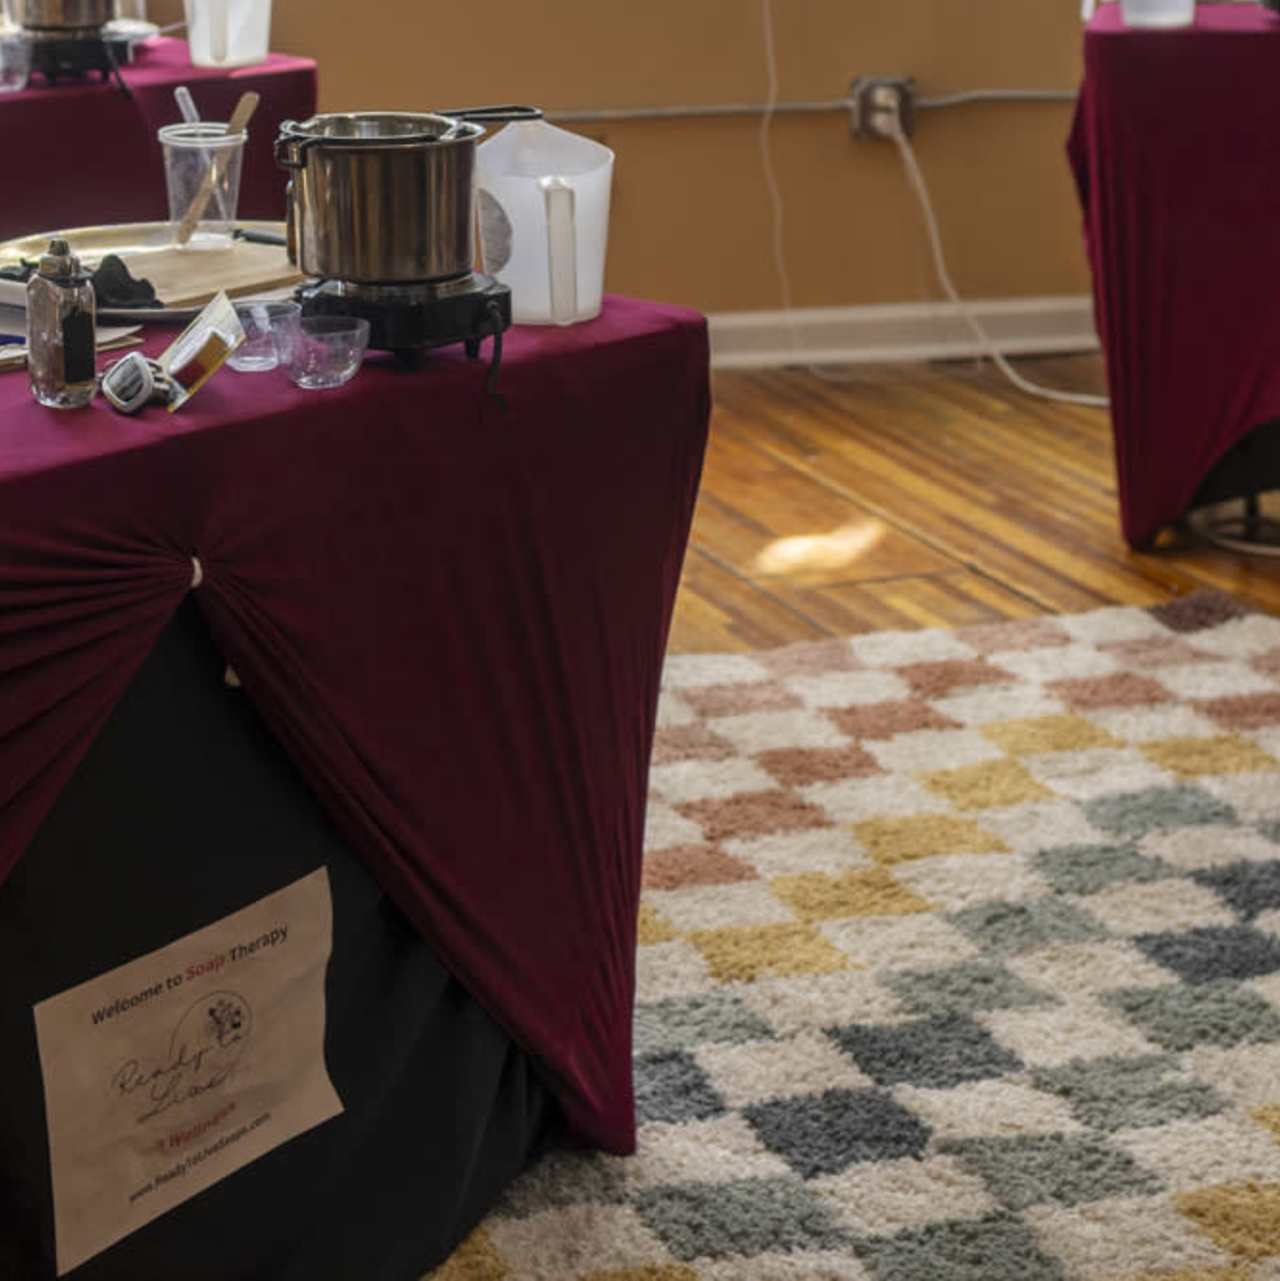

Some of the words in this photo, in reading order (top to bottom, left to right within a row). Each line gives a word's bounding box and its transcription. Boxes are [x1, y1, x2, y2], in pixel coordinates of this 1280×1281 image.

[91, 982, 163, 1025] Welcome
[166, 973, 184, 991] to
[185, 953, 226, 982] Soap
[228, 923, 289, 962] Therapy
